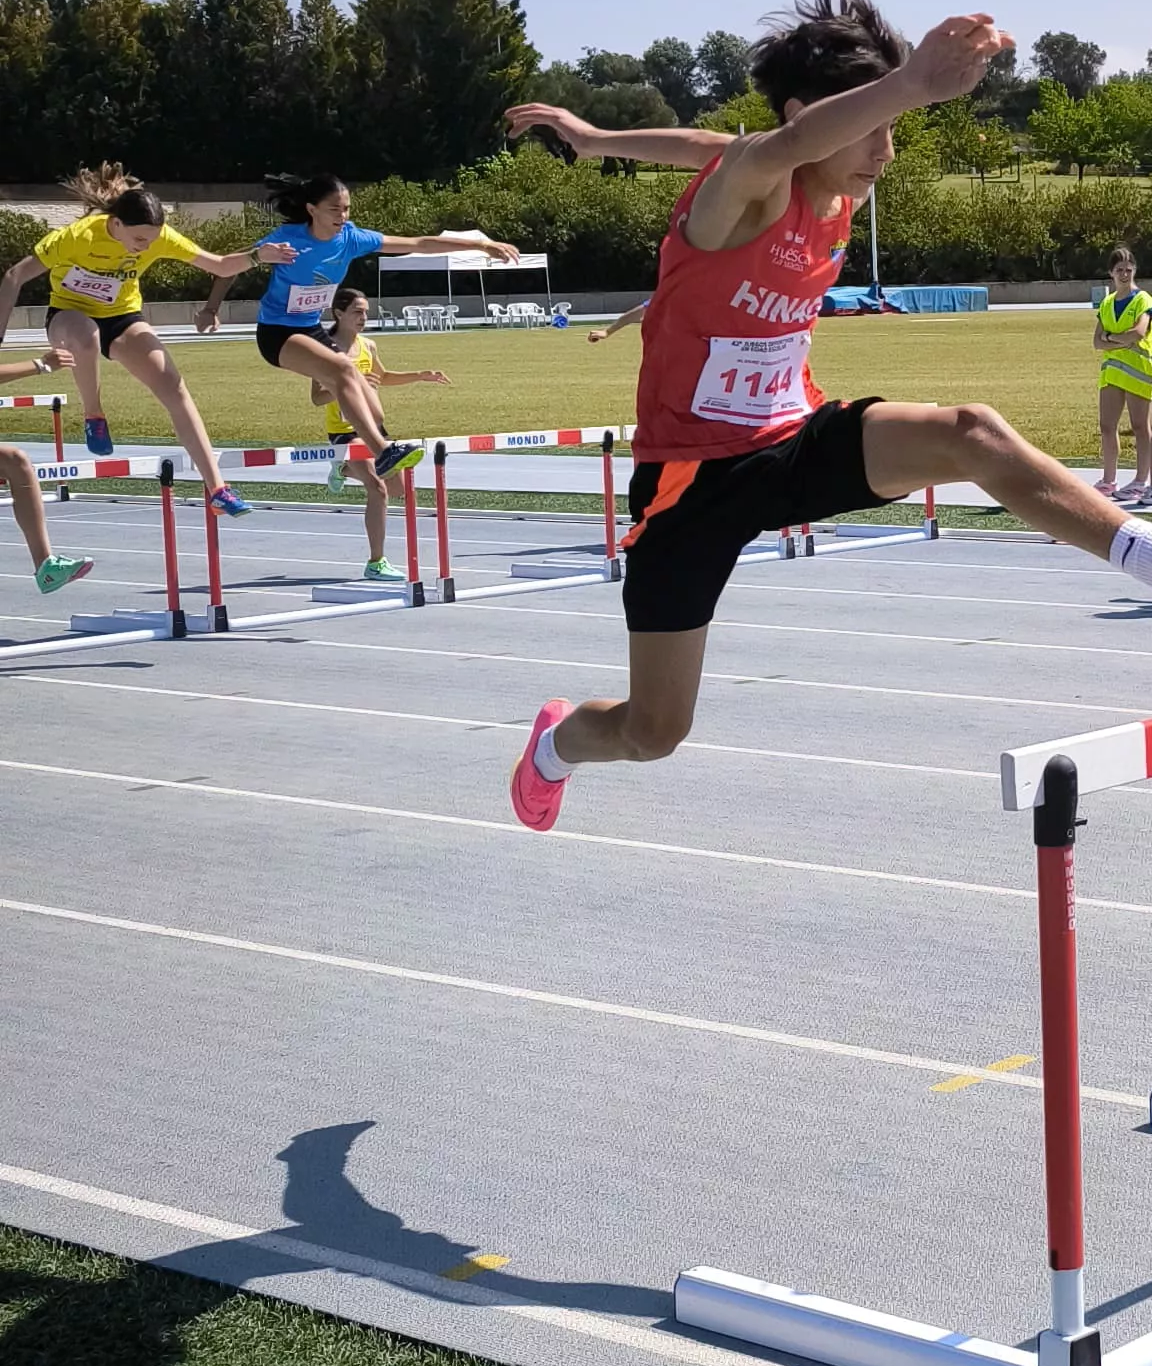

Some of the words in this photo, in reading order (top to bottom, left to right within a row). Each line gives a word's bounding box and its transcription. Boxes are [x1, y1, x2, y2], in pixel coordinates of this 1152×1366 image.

[73, 280, 112, 293] 1502
[296, 294, 328, 306] 1631
[719, 366, 793, 398] 1144
[508, 435, 546, 446] MONDO
[290, 448, 336, 461] MONDO
[37, 466, 79, 479] ONDO
